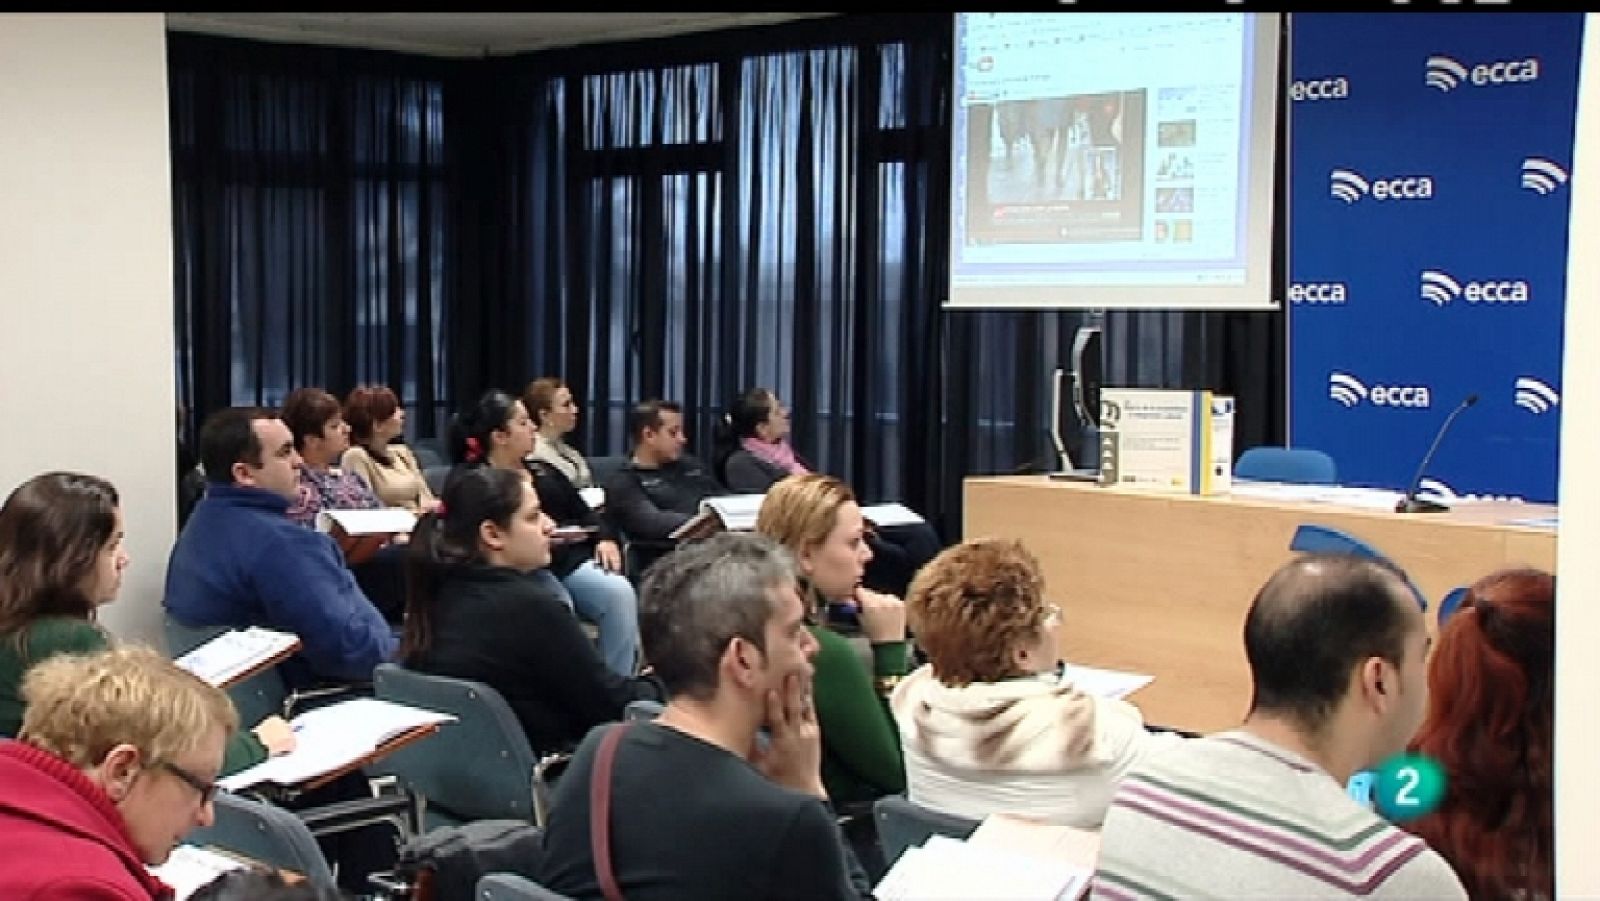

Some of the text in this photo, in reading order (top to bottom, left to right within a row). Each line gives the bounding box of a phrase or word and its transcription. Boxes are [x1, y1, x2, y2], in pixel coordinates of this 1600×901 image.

[1471, 59, 1538, 85] ecca
[1290, 78, 1348, 101] ecca
[1372, 177, 1432, 198] ecca
[1288, 282, 1346, 302] ecca
[1464, 281, 1528, 302] ecca
[1370, 386, 1430, 407] ecca
